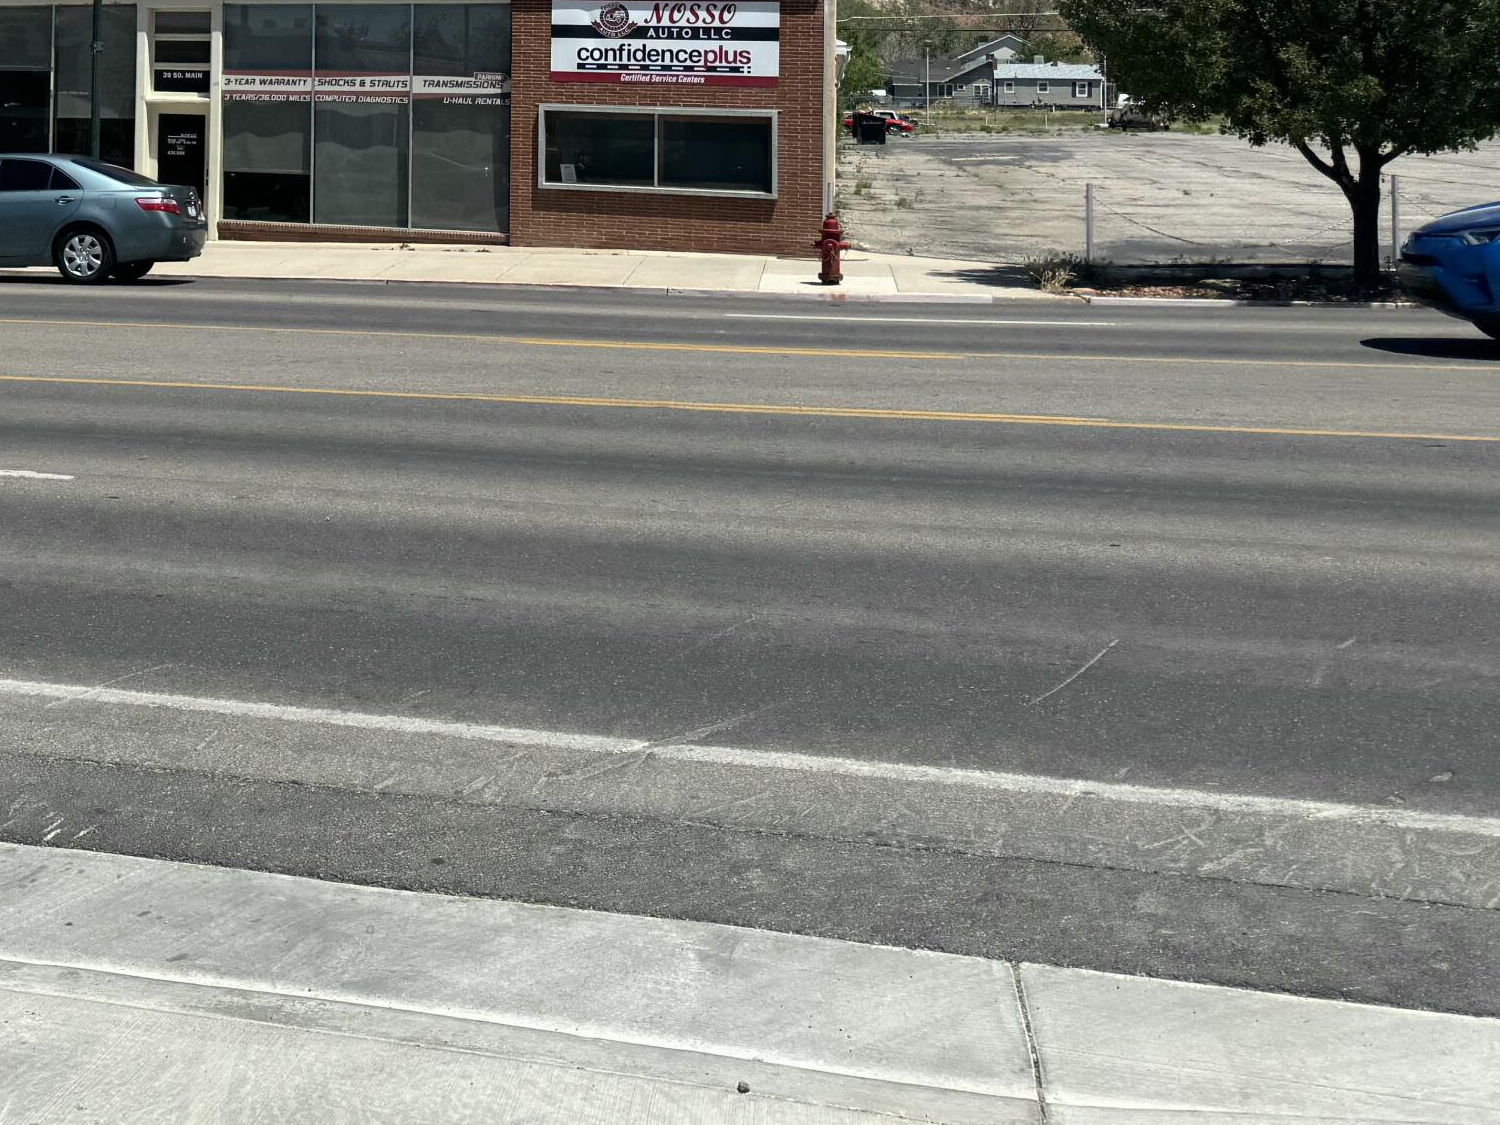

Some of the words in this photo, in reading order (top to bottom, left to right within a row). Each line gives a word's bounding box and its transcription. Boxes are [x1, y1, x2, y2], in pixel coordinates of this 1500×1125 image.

[643, 2, 736, 24] NOSSO
[647, 28, 692, 38] AUTO
[700, 28, 732, 38] LLC
[224, 78, 256, 86] 3-YEAR
[259, 78, 308, 86] WARRANTY
[317, 78, 357, 87] SHOCKS
[359, 79, 366, 87] &
[369, 79, 408, 88] STRUTS
[422, 79, 503, 89] TRANSMISSIONS
[620, 74, 650, 82] Certified
[651, 75, 677, 83] Service
[678, 75, 705, 84] Centers
[288, 94, 311, 102] MILES
[315, 94, 356, 102] COMPUTER
[358, 96, 409, 104] DIAGNOSTICS
[475, 97, 510, 105] RENTALS
